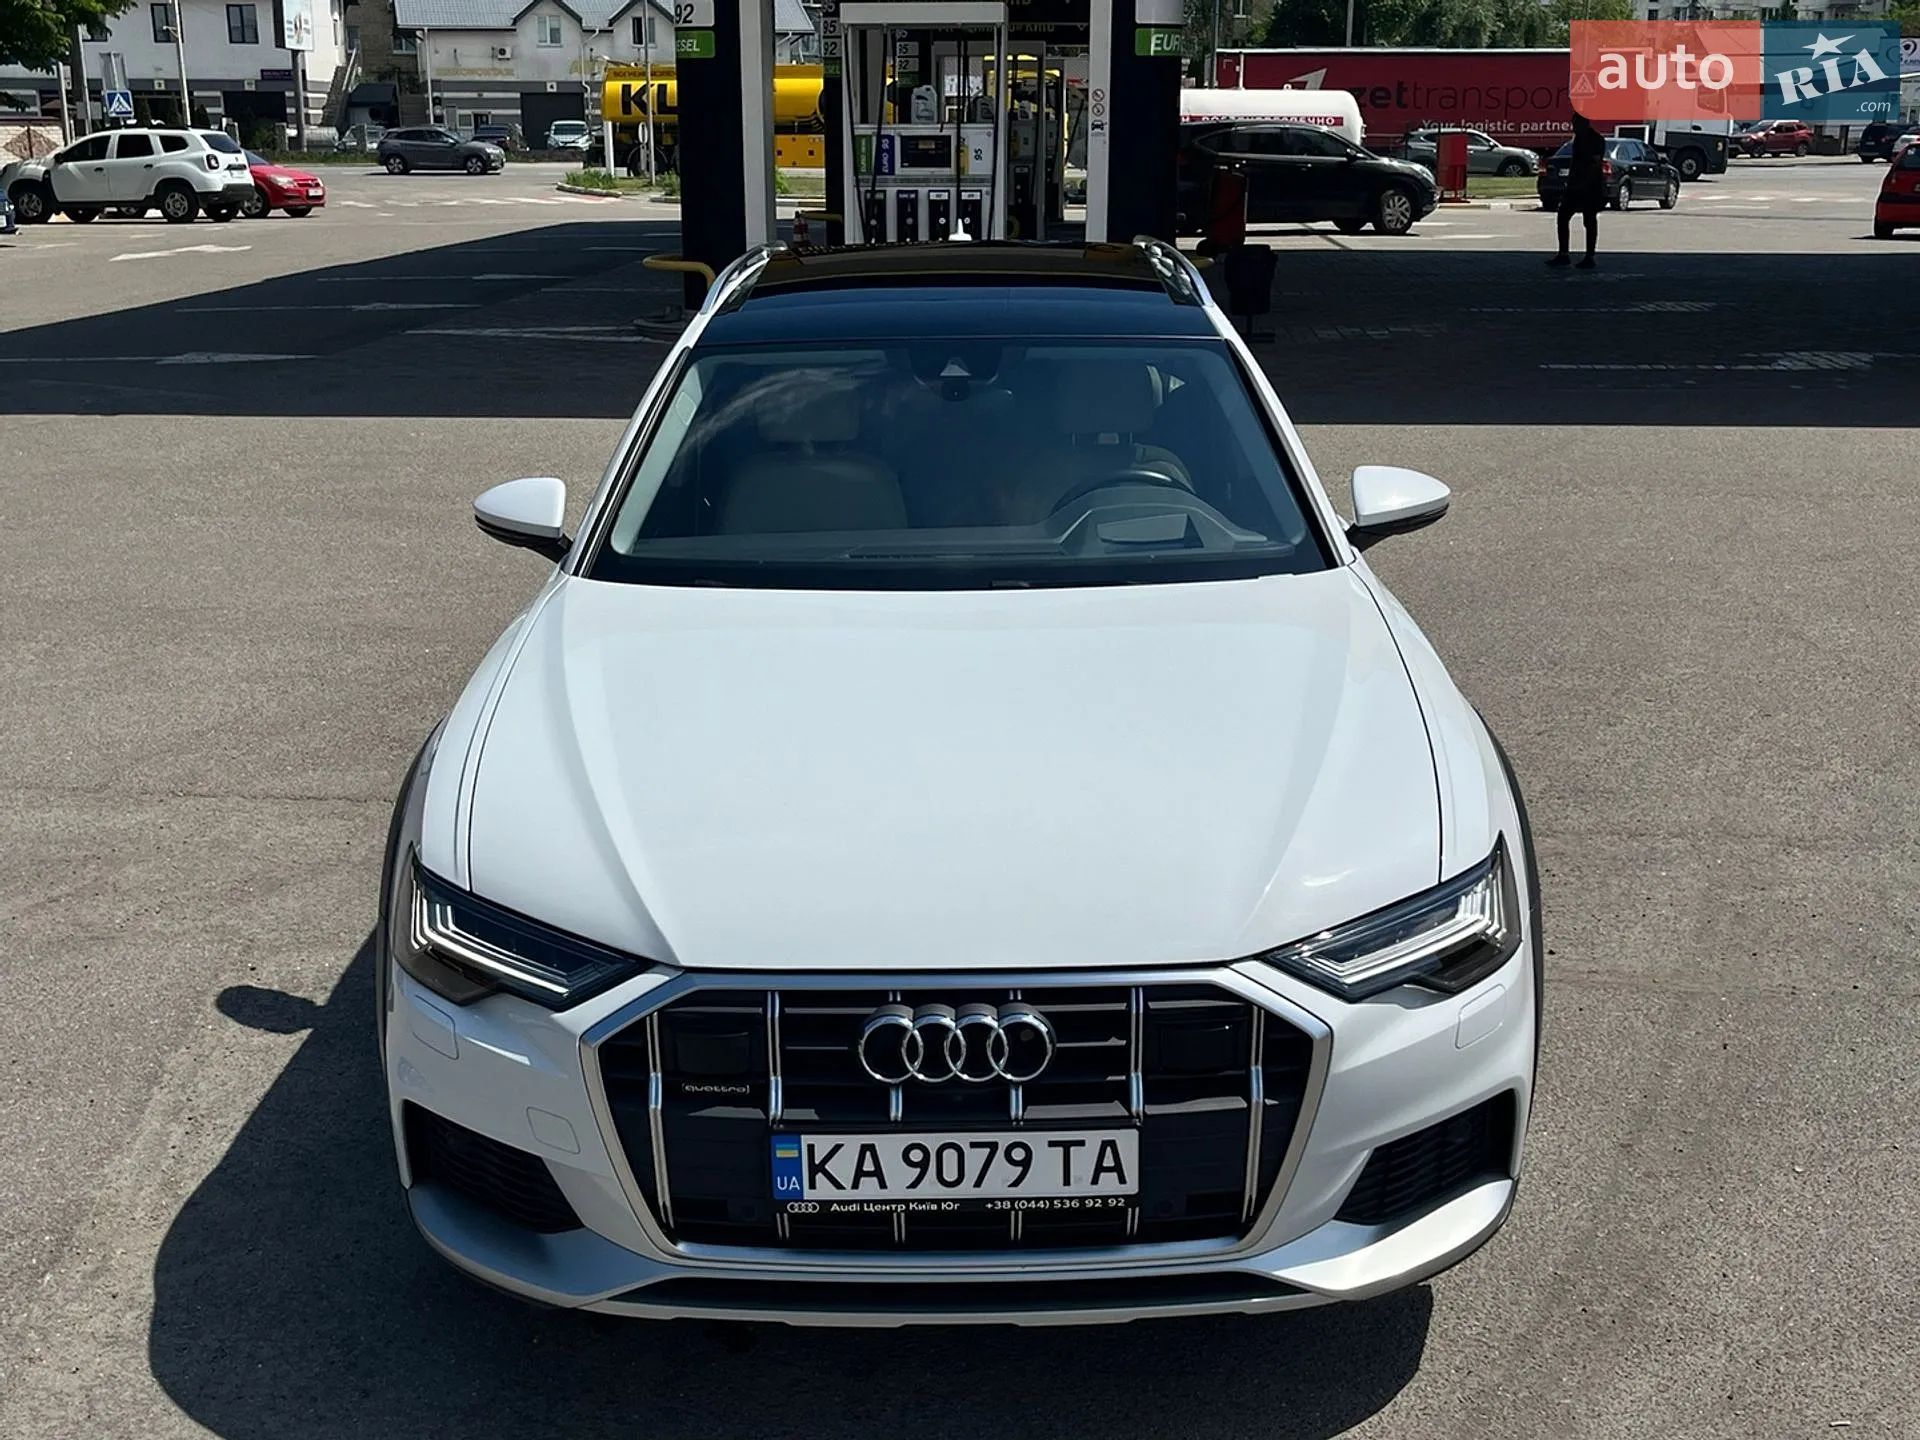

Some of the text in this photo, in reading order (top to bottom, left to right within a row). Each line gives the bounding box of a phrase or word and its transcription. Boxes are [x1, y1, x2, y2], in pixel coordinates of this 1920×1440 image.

[807, 1139, 1128, 1190] KA 9079 TA
[777, 1176, 801, 1191] UA
[830, 1201, 960, 1213] Audi Центр Київ Юг
[985, 1197, 1125, 1210] +38 (044) 536 92 92
